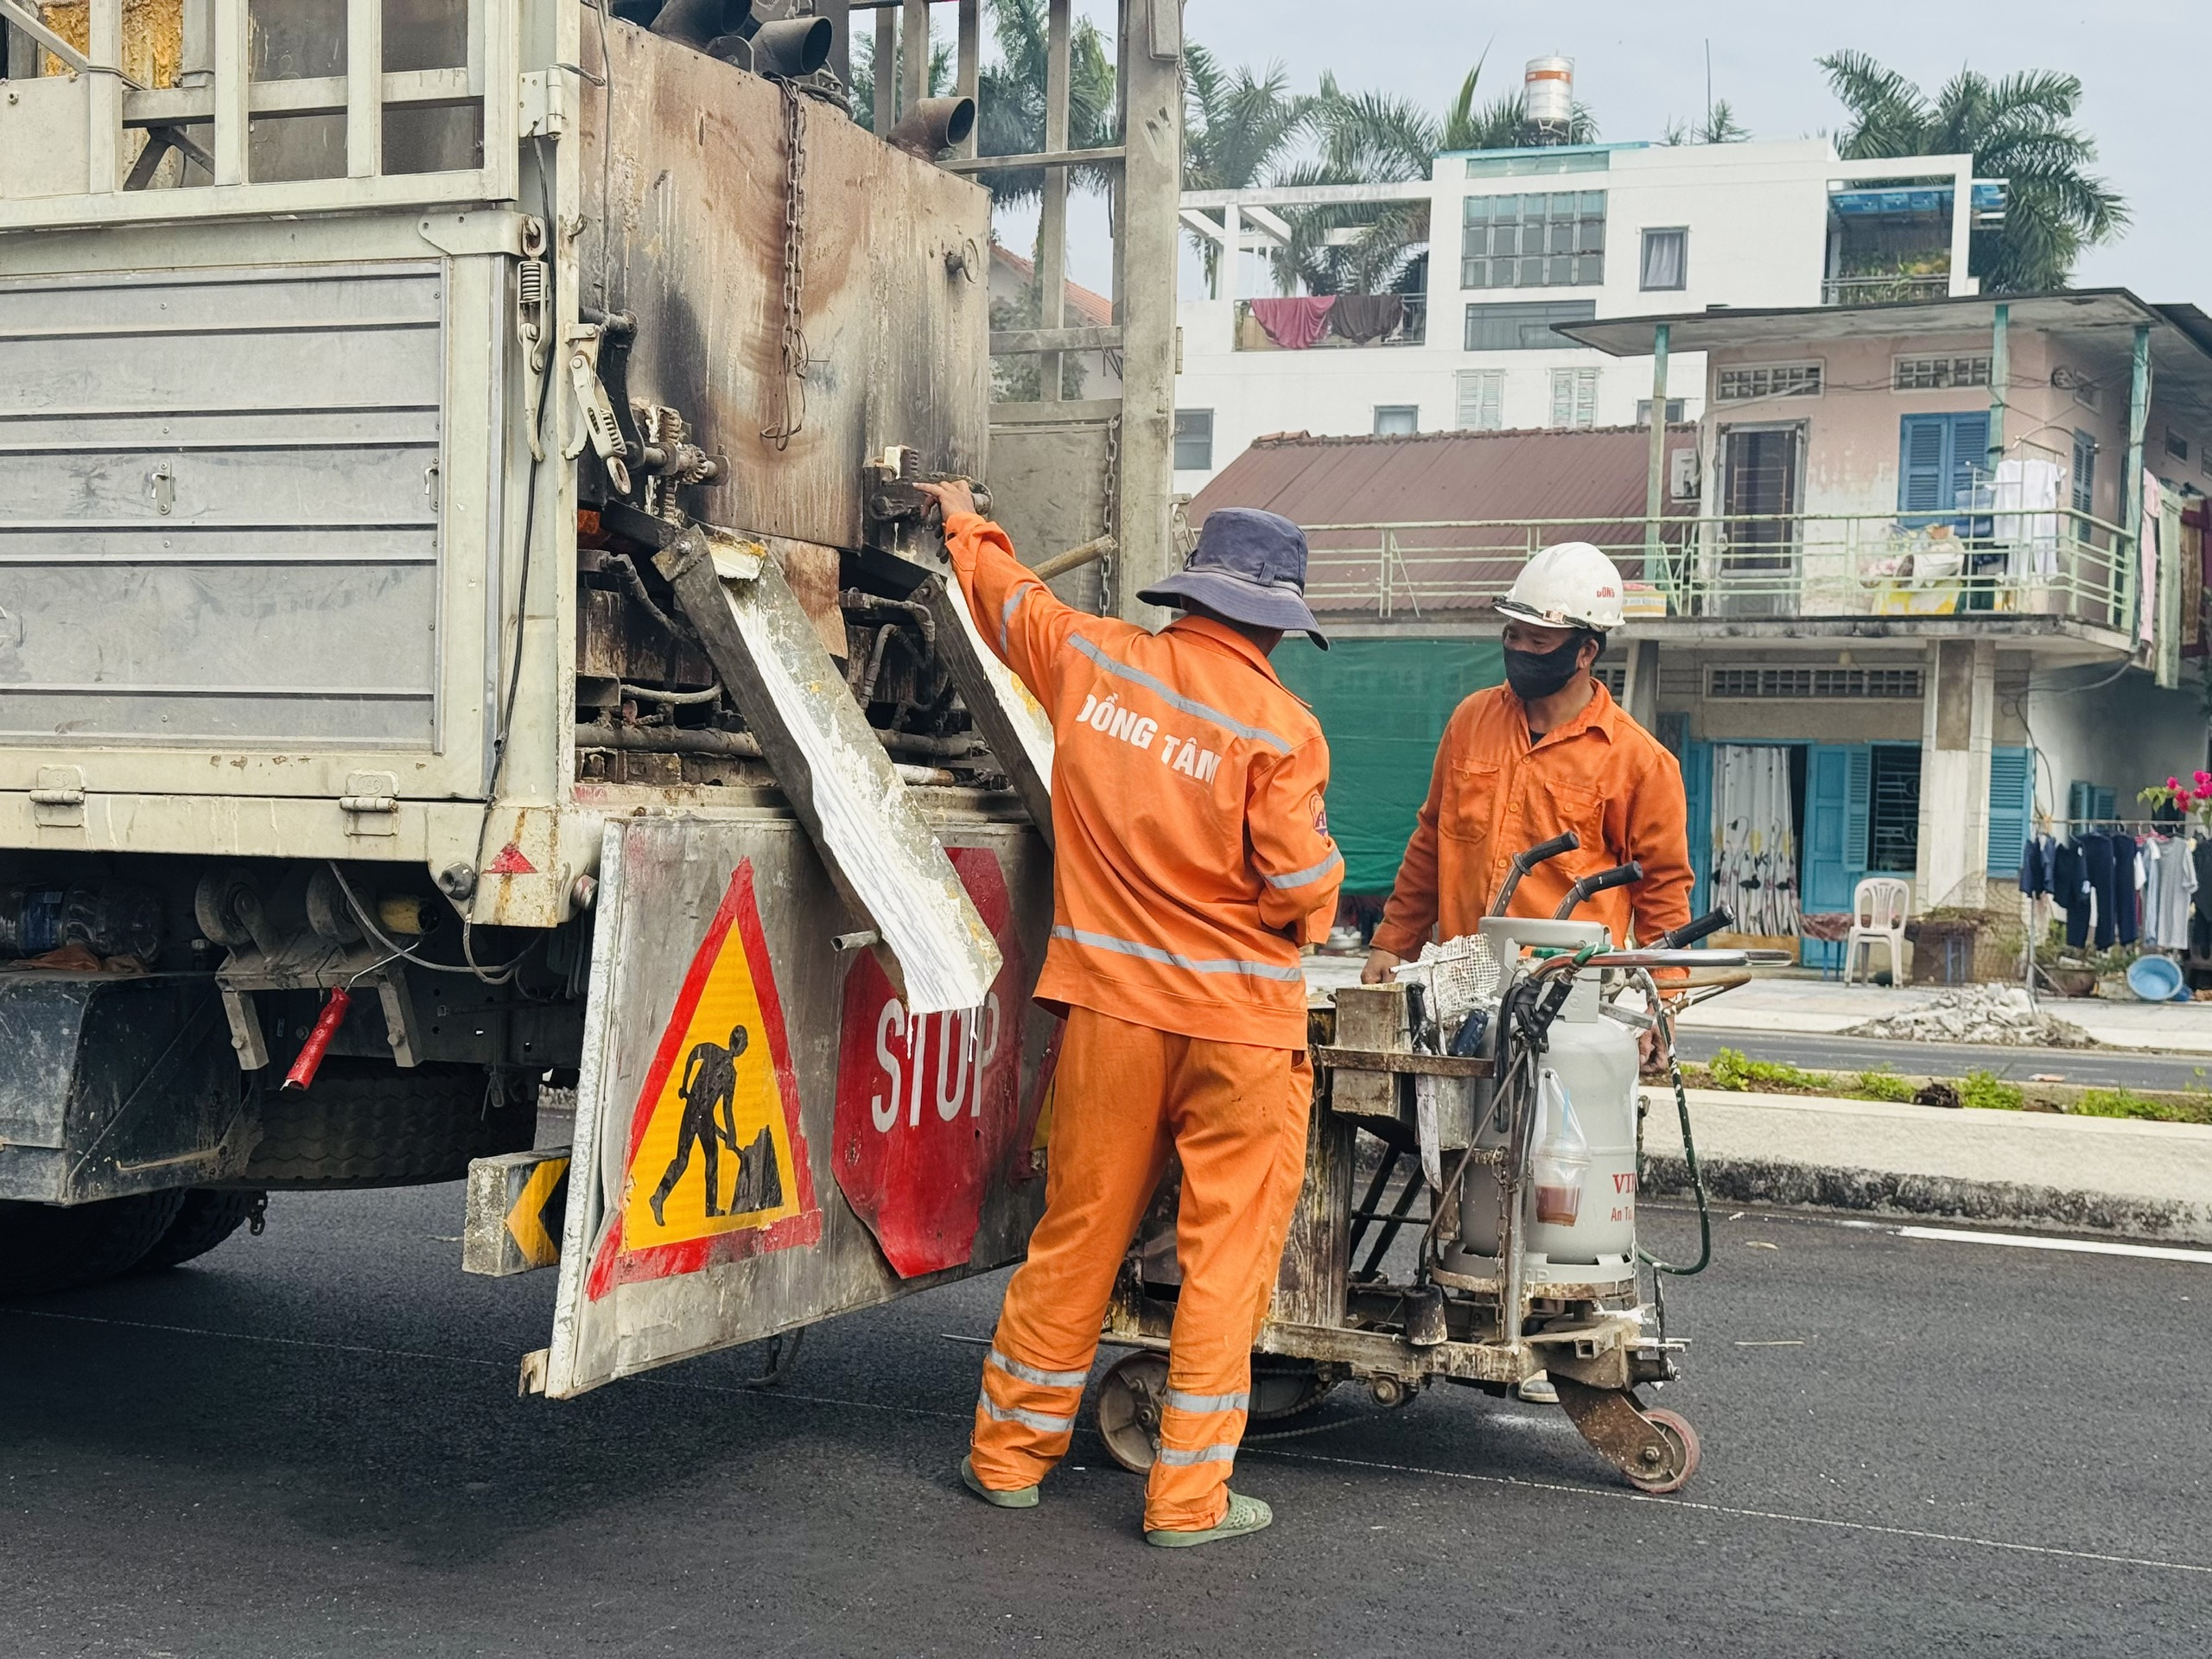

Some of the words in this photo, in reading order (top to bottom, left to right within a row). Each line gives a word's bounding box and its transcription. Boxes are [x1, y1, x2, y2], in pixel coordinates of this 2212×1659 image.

[1160, 734, 1222, 785] TÂM
[871, 992, 1001, 1133] STOP
[1611, 1207, 1622, 1222] An
